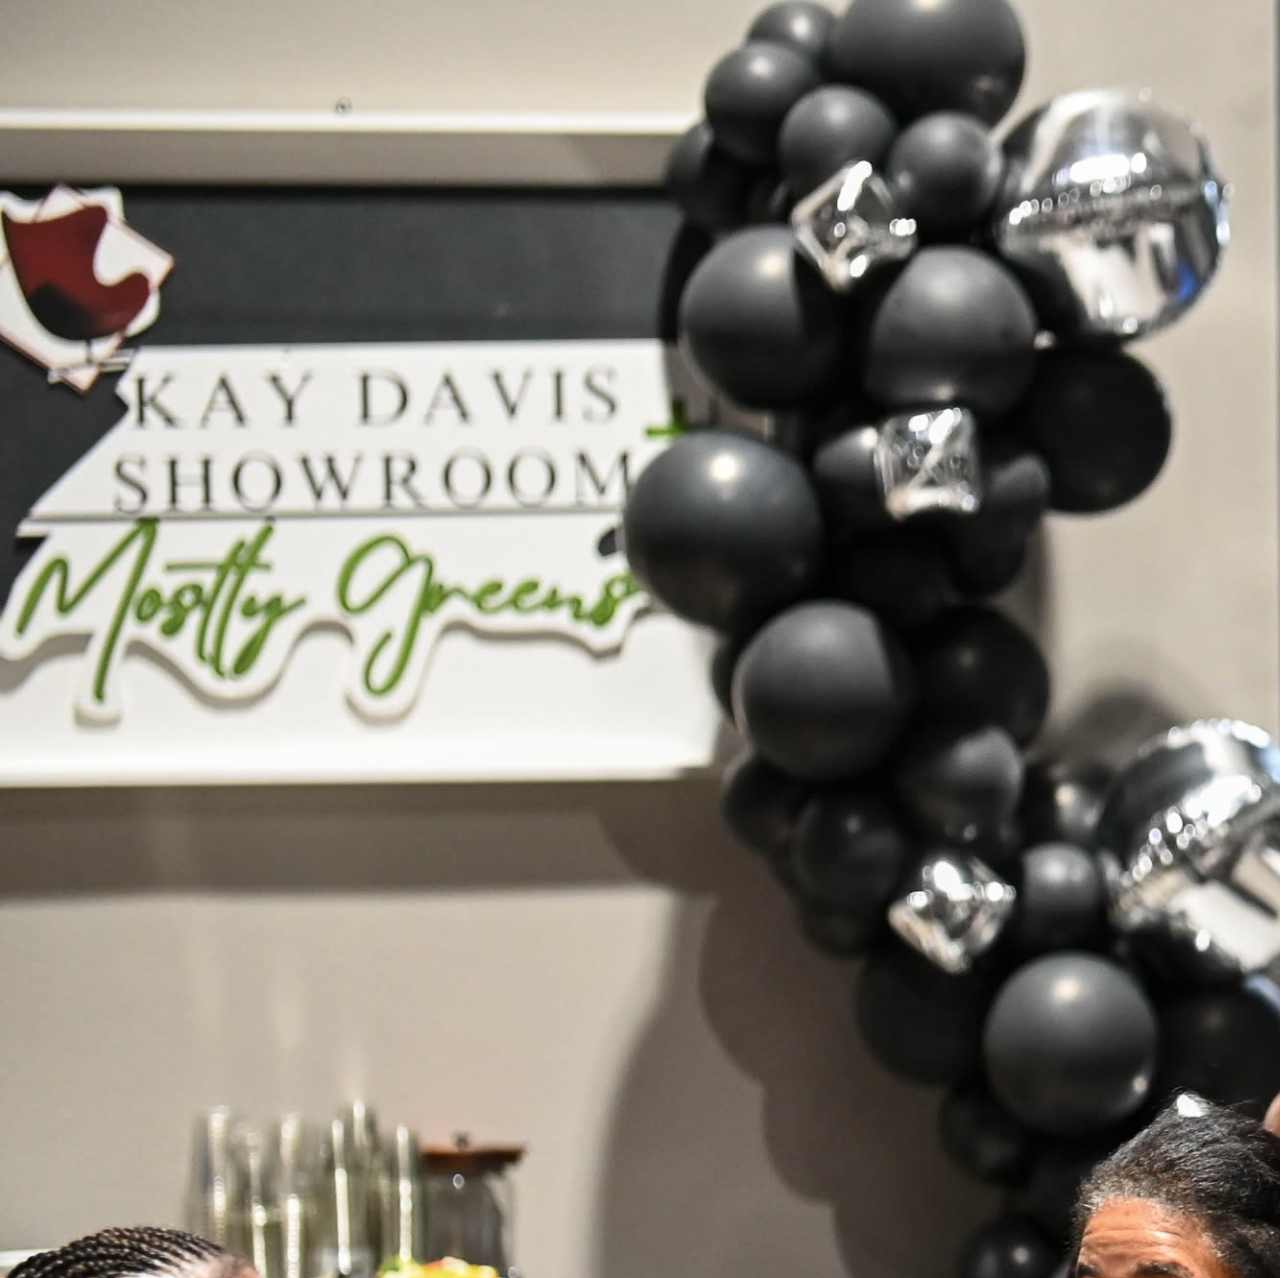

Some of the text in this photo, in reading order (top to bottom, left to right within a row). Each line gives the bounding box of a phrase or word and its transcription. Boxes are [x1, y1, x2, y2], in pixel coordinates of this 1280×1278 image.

[134, 365, 621, 430] KAY DAVIS
[112, 448, 633, 515] SHOWROOM
[15, 517, 641, 703] Mostly Greens
